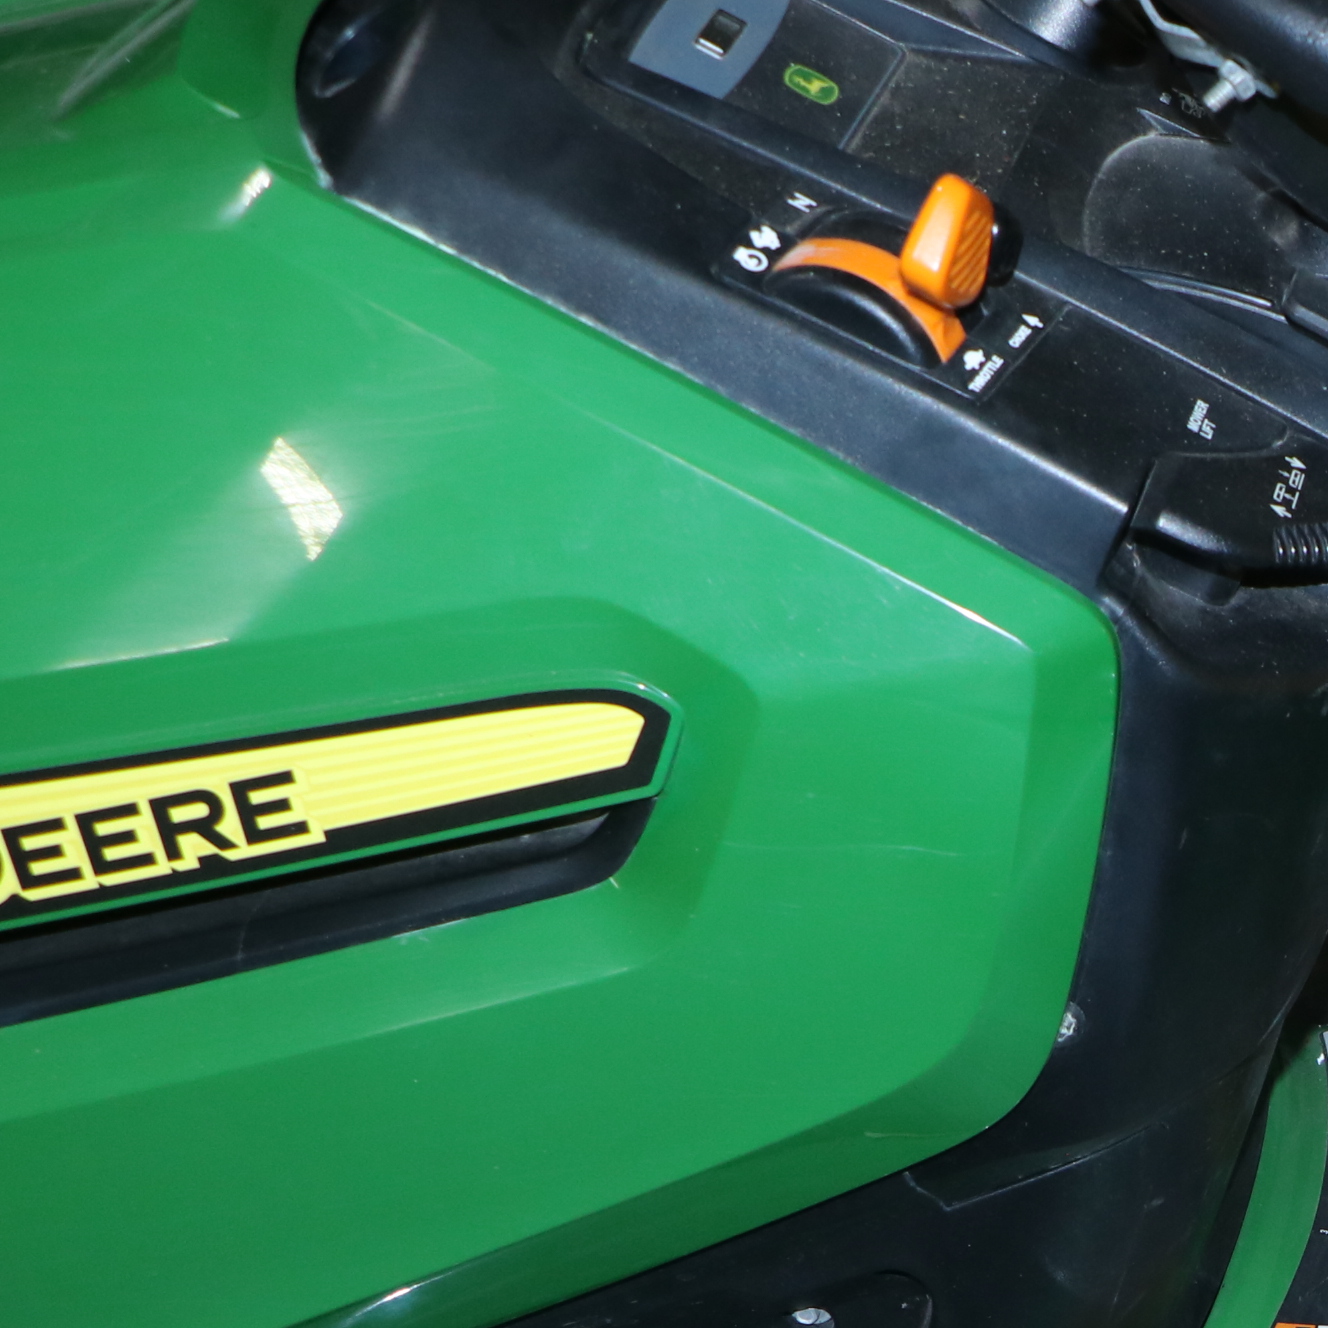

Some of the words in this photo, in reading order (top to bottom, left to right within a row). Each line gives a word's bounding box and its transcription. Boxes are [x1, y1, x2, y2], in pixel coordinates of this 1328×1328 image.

[967, 354, 1004, 393] THROTTLE
[1186, 399, 1209, 433] MOWER
[1199, 418, 1216, 440] LIFT
[0, 769, 311, 891] EERE
